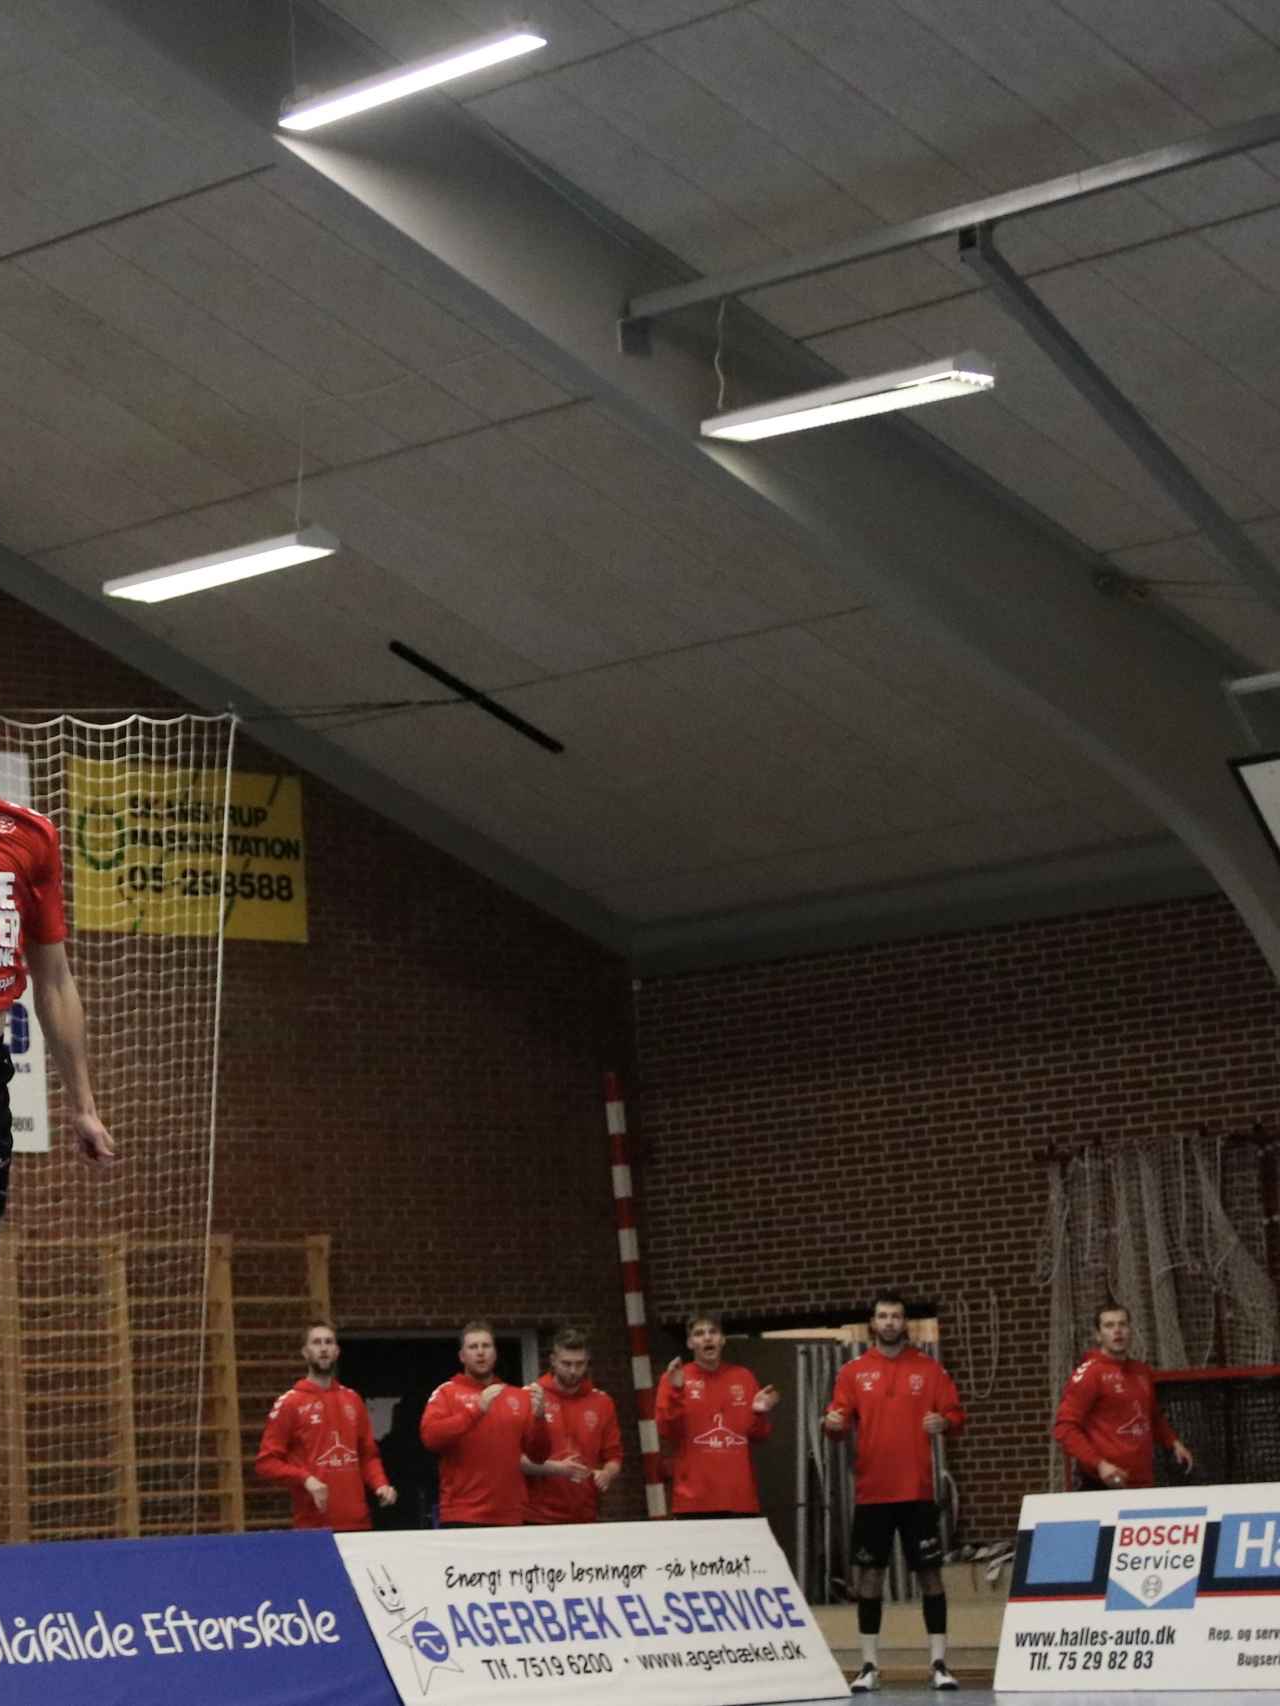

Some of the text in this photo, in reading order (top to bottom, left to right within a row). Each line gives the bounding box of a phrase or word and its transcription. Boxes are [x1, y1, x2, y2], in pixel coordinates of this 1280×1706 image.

[1119, 1523, 1200, 1548] BOSCH
[1233, 1520, 1280, 1569] H
[444, 1565, 502, 1595] Energi
[509, 1562, 566, 1593] rigtige
[570, 1560, 647, 1589] løsninger
[1115, 1550, 1195, 1571] Service
[141, 1598, 341, 1656] Efterskole
[447, 1586, 806, 1648] AGERBÆK EL-SERVICE
[1015, 1625, 1176, 1649] www.halles-auto.dk
[1208, 1626, 1233, 1642] Rep.
[1237, 1628, 1252, 1642] og
[481, 1641, 807, 1680] Tlf. 7519 6200 www.agerbækel.dk
[1029, 1651, 1052, 1672] Tlf.
[1058, 1651, 1077, 1671] 75
[1082, 1650, 1102, 1671] 29
[1108, 1650, 1127, 1670] 82
[1132, 1650, 1154, 1670] 83
